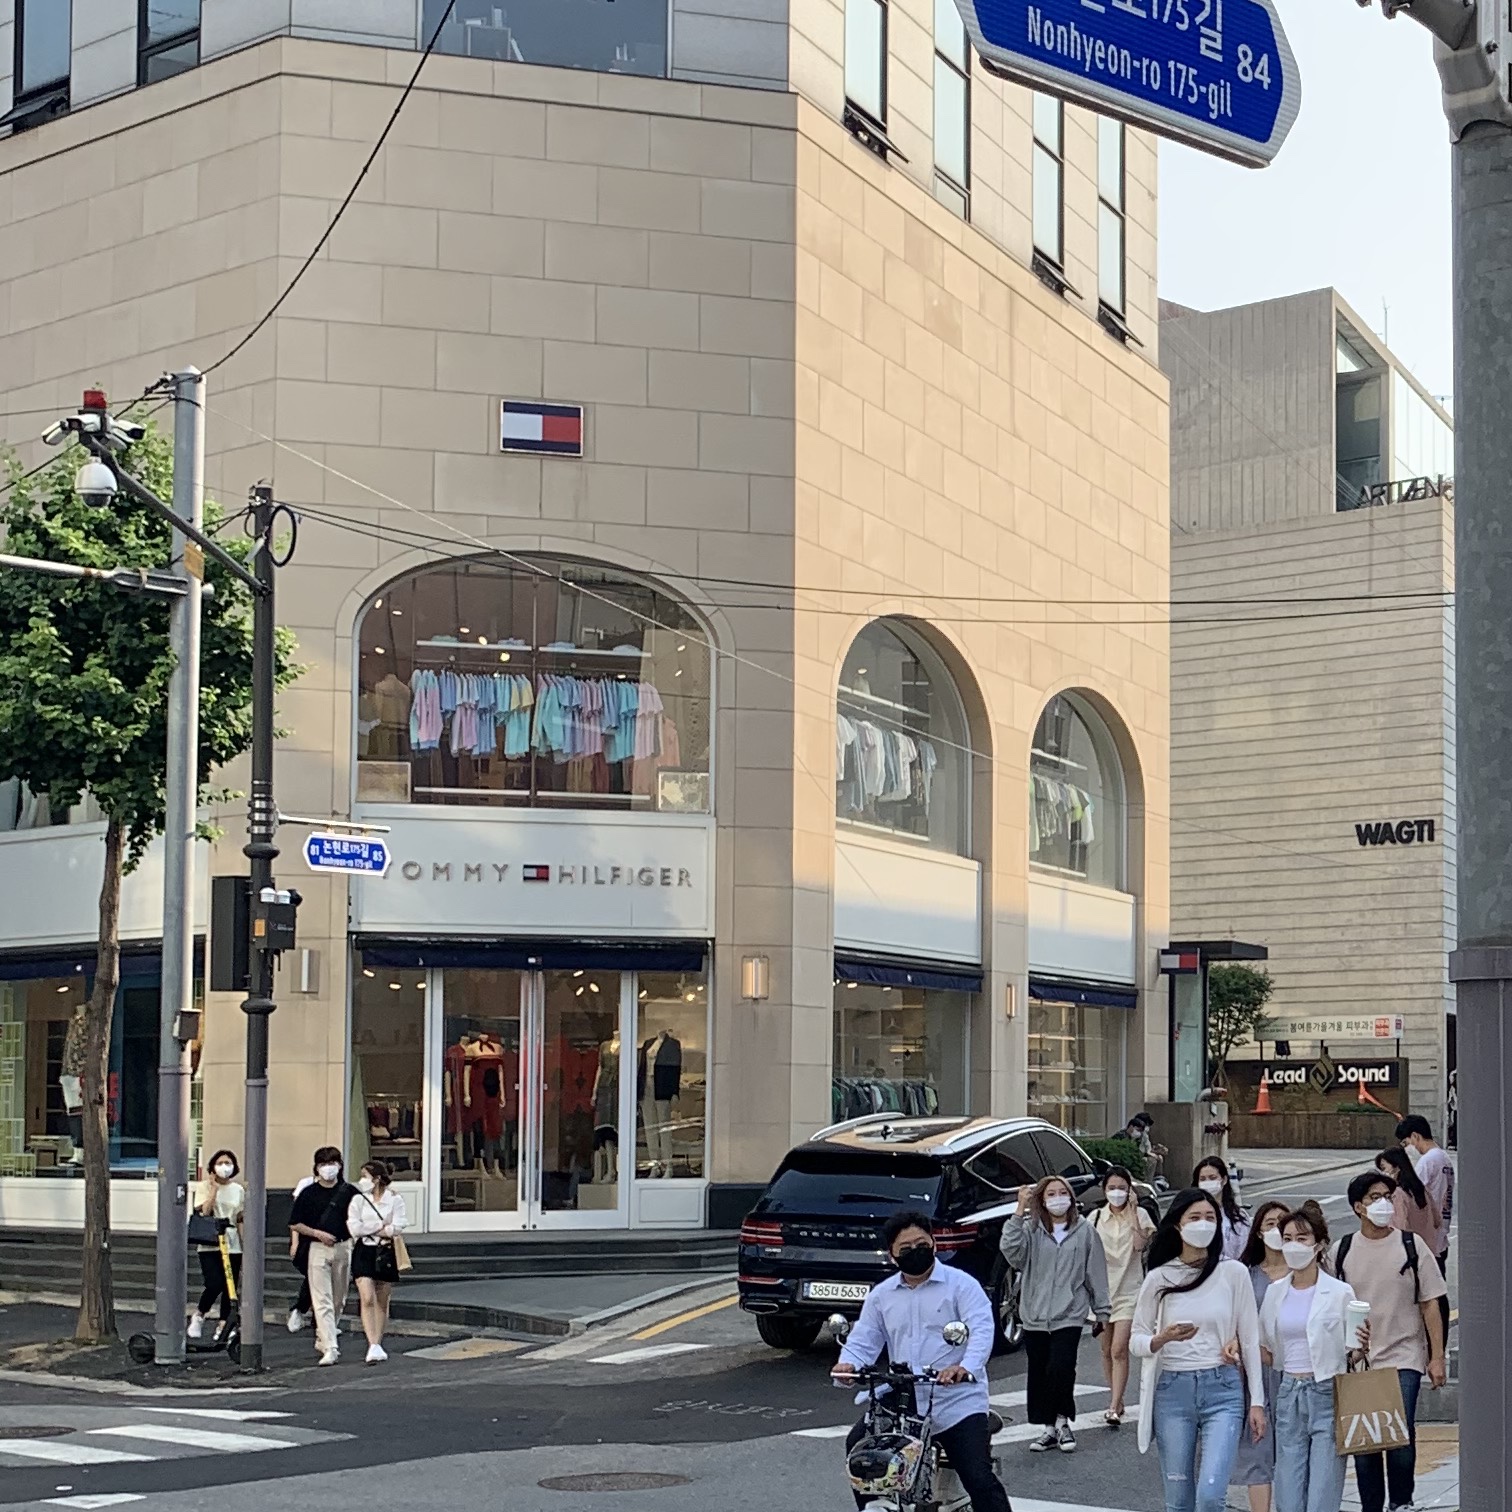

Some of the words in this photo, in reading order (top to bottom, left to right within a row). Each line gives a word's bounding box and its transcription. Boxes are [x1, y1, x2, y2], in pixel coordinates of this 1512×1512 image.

[1028, 6, 1161, 90] Nonhyeon-ro
[1168, 59, 1232, 119] 175-gil
[1237, 43, 1271, 90] 84
[1355, 819, 1435, 846] WAGTI
[310, 844, 319, 856] 81
[372, 850, 383, 862] 85
[384, 860, 509, 882] OMMY
[558, 863, 693, 888] HILFIGER
[1290, 1021, 1342, 1033] 봄여름가을겨울
[1346, 1021, 1369, 1032] 피부과
[1264, 1067, 1306, 1084] Lead
[1338, 1064, 1389, 1083] Sound
[841, 1285, 868, 1298] 5639
[1341, 1408, 1410, 1449] ZARA
